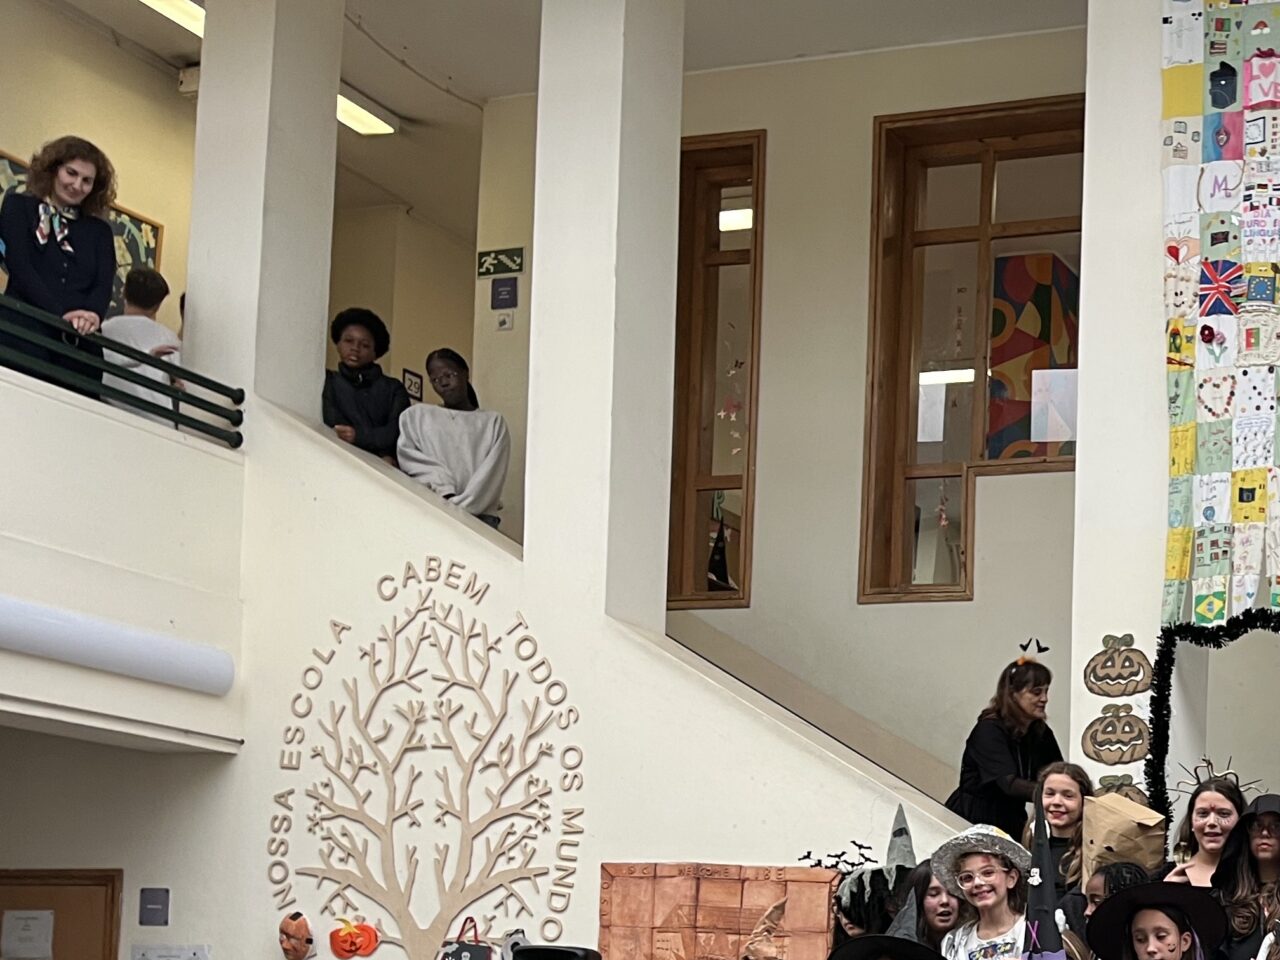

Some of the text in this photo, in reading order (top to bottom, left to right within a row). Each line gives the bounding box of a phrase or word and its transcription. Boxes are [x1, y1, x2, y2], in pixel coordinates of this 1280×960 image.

[376, 555, 491, 606] CABEM
[279, 618, 353, 771] ESCOLA
[504, 611, 580, 732] TODOS
[559, 744, 585, 793] OS
[267, 787, 297, 912] NOSSA
